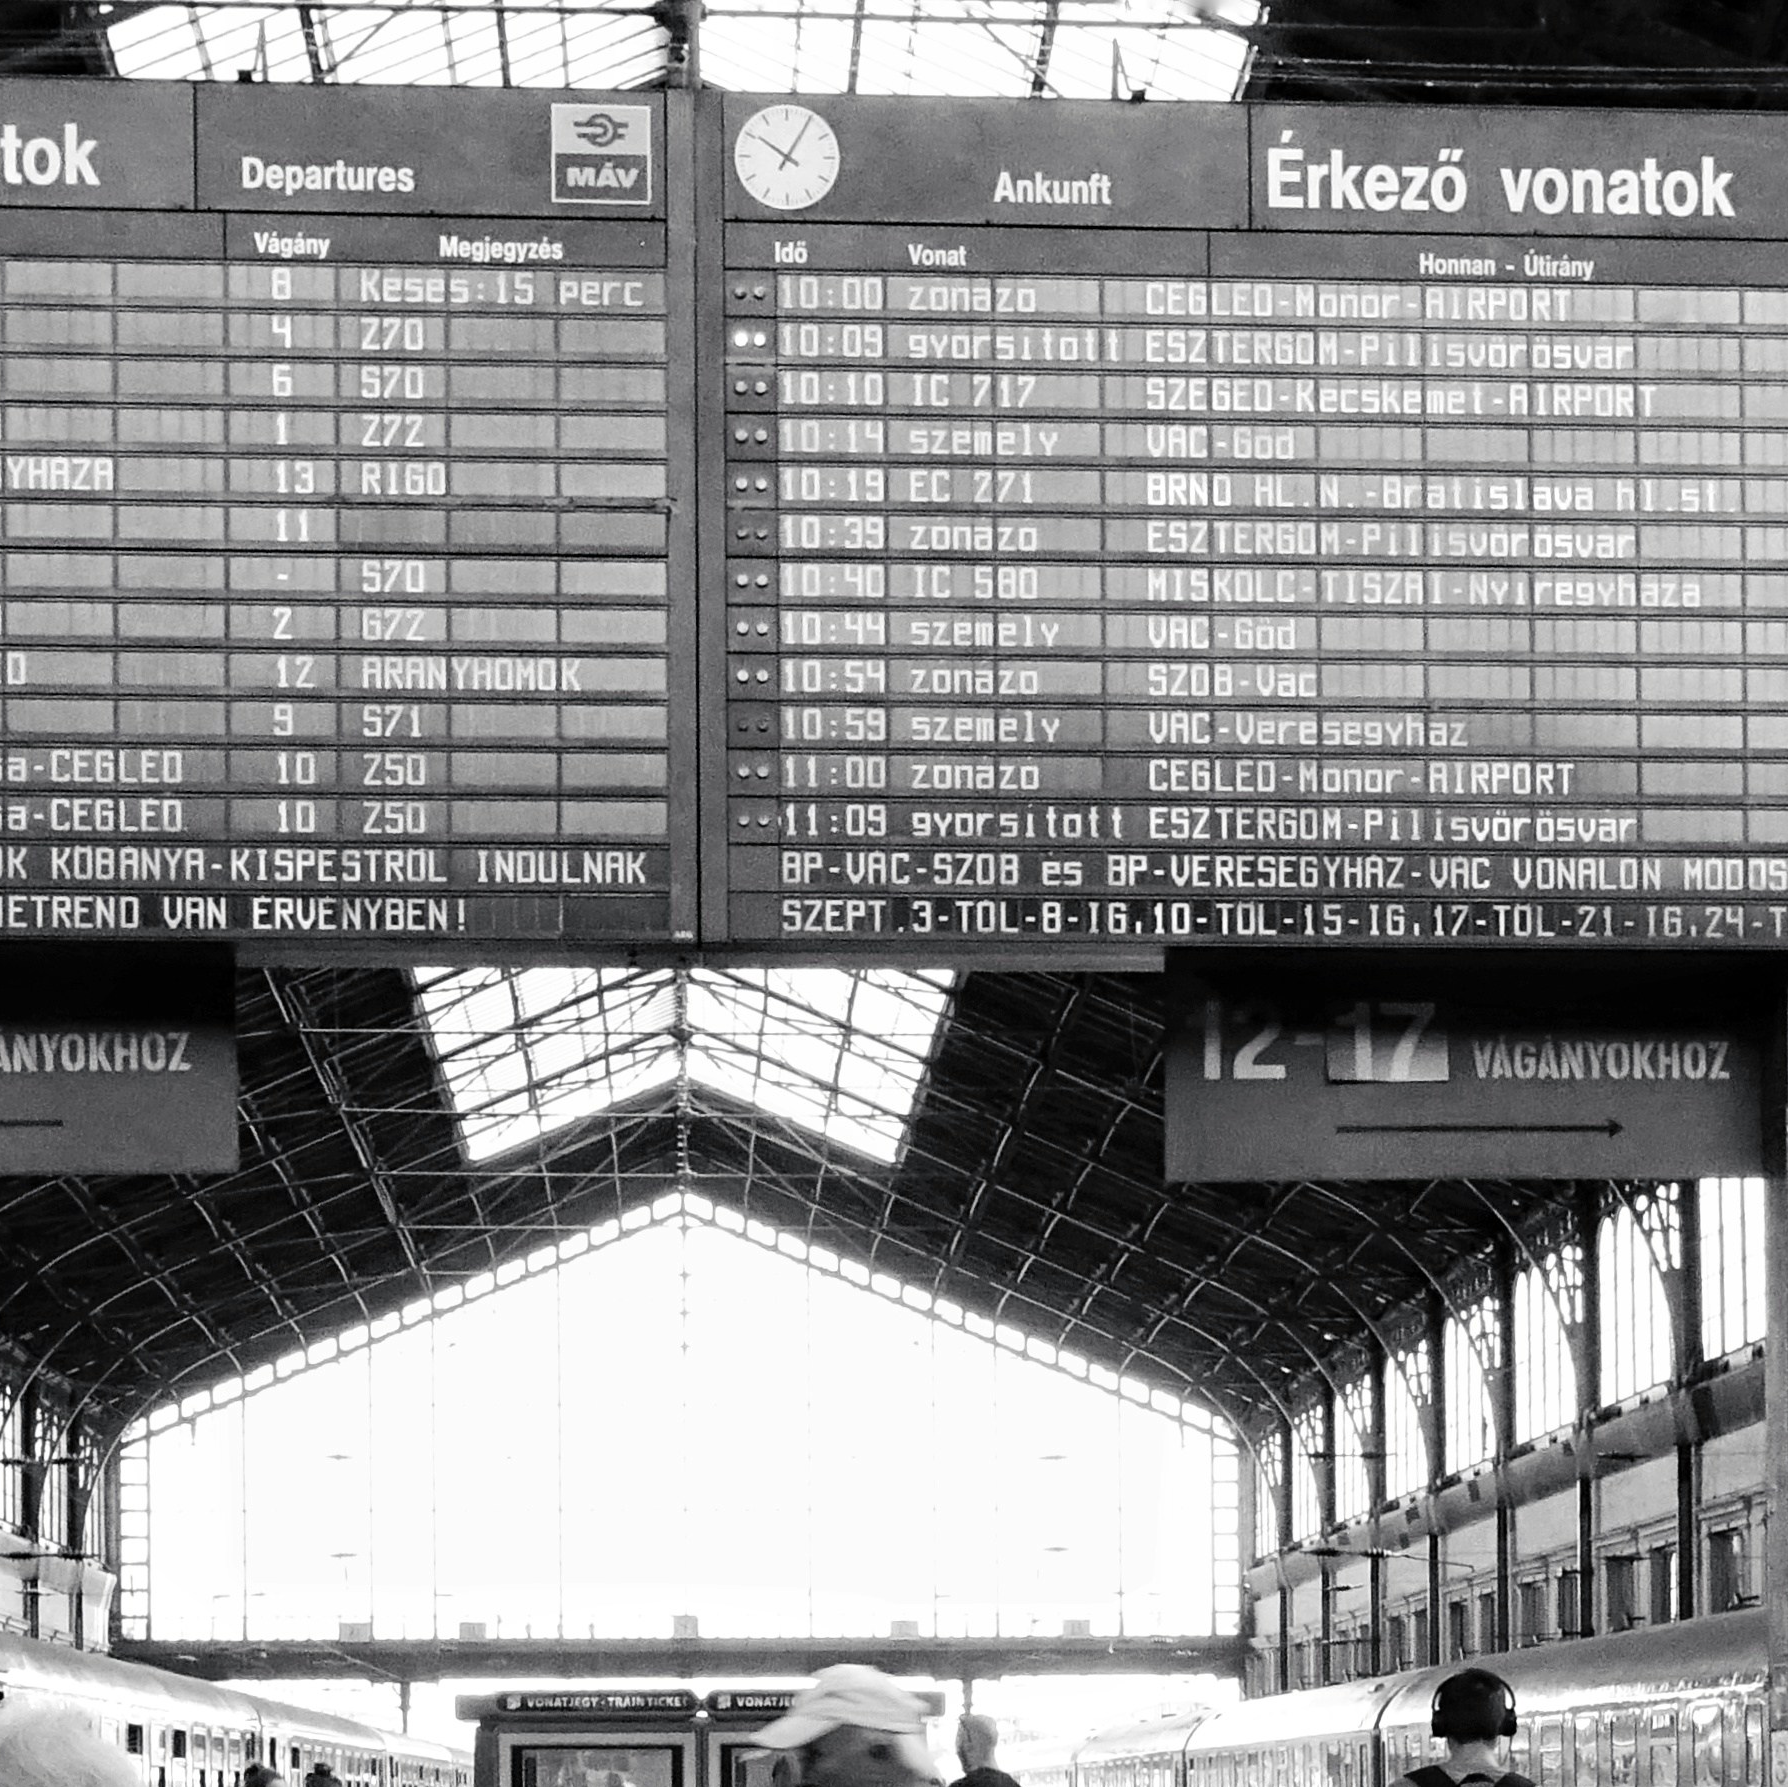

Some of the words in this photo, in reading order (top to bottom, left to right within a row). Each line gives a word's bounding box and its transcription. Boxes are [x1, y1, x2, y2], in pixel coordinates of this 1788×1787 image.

[242, 157, 414, 195] Departures
[567, 161, 639, 189] MÁV
[994, 172, 1111, 204] Ankunft
[1266, 131, 1467, 212] Érkező
[1500, 156, 1735, 216] vonatok
[254, 231, 330, 259] Vágány
[440, 236, 563, 263] Megjegyzés
[775, 241, 807, 263] Idő
[908, 244, 966, 266] Vonat
[1420, 253, 1495, 275] Honnan
[1524, 249, 1594, 280] Útirány
[273, 266, 293, 300] 8
[559, 271, 644, 305] perc
[783, 275, 885, 309] 10:00
[273, 315, 293, 348] 4
[783, 323, 885, 358] 10:09
[273, 363, 293, 396] 6
[362, 364, 426, 398] S70
[783, 371, 885, 406] 10:10
[912, 373, 949, 407] IC
[973, 374, 1036, 408] 717
[276, 412, 293, 445] 1
[783, 419, 886, 454] 10:14
[276, 460, 315, 493] 13
[362, 461, 448, 495] RIGO
[783, 468, 886, 502] 10:19
[910, 469, 950, 503] EC
[974, 470, 1037, 504] 271
[1148, 472, 1231, 506] BRNO
[277, 508, 315, 542] 11
[783, 516, 886, 550] 10:39
[362, 558, 426, 592] S70
[783, 564, 886, 598] 10:40
[913, 565, 950, 599] IC
[974, 566, 1037, 600] 580
[274, 606, 293, 639] 2
[783, 612, 886, 646] 10:44
[277, 655, 316, 688] 12
[362, 655, 580, 691] ARANYHOMOK
[783, 660, 886, 694] 10:54
[274, 703, 294, 736] 9
[363, 704, 427, 738] S71
[784, 708, 886, 742] 10:59
[277, 752, 316, 785] 10
[784, 756, 887, 790] 11:00
[277, 801, 316, 834] 10
[784, 804, 887, 838] 11:09
[477, 852, 646, 886] INDULNAK
[1513, 856, 1659, 890] VONALON
[163, 896, 227, 930] VAN
[1473, 1033, 1731, 1081] VÁGÁNYOKHOZ
[527, 1696, 599, 1708] VONATJEGY
[607, 1696, 645, 1708] TRAIN
